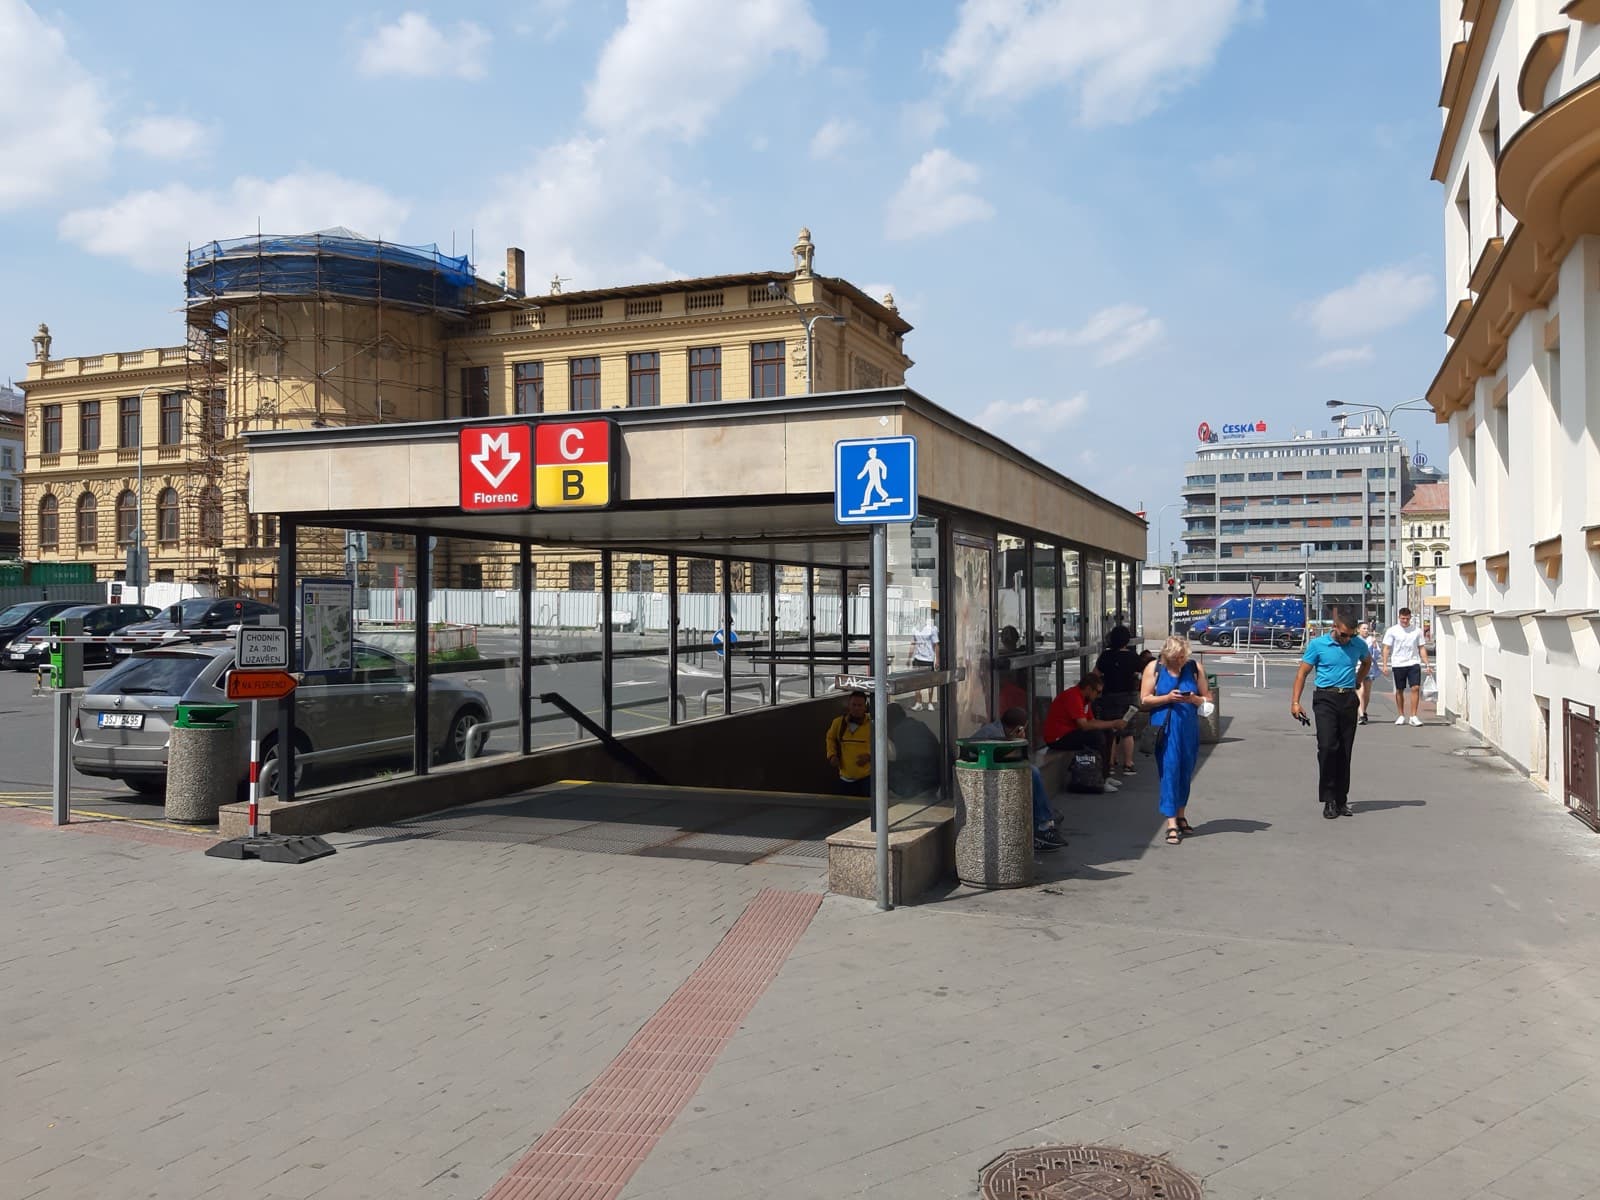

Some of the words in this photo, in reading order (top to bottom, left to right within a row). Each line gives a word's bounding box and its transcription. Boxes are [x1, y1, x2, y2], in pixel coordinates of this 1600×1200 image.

[1222, 421, 1254, 433] ČESKÁ
[559, 428, 584, 460] C
[562, 469, 585, 501] B
[473, 492, 518, 504] Florenc
[246, 633, 280, 642] CHODNÍK
[245, 654, 281, 663] UZAVŘEN
